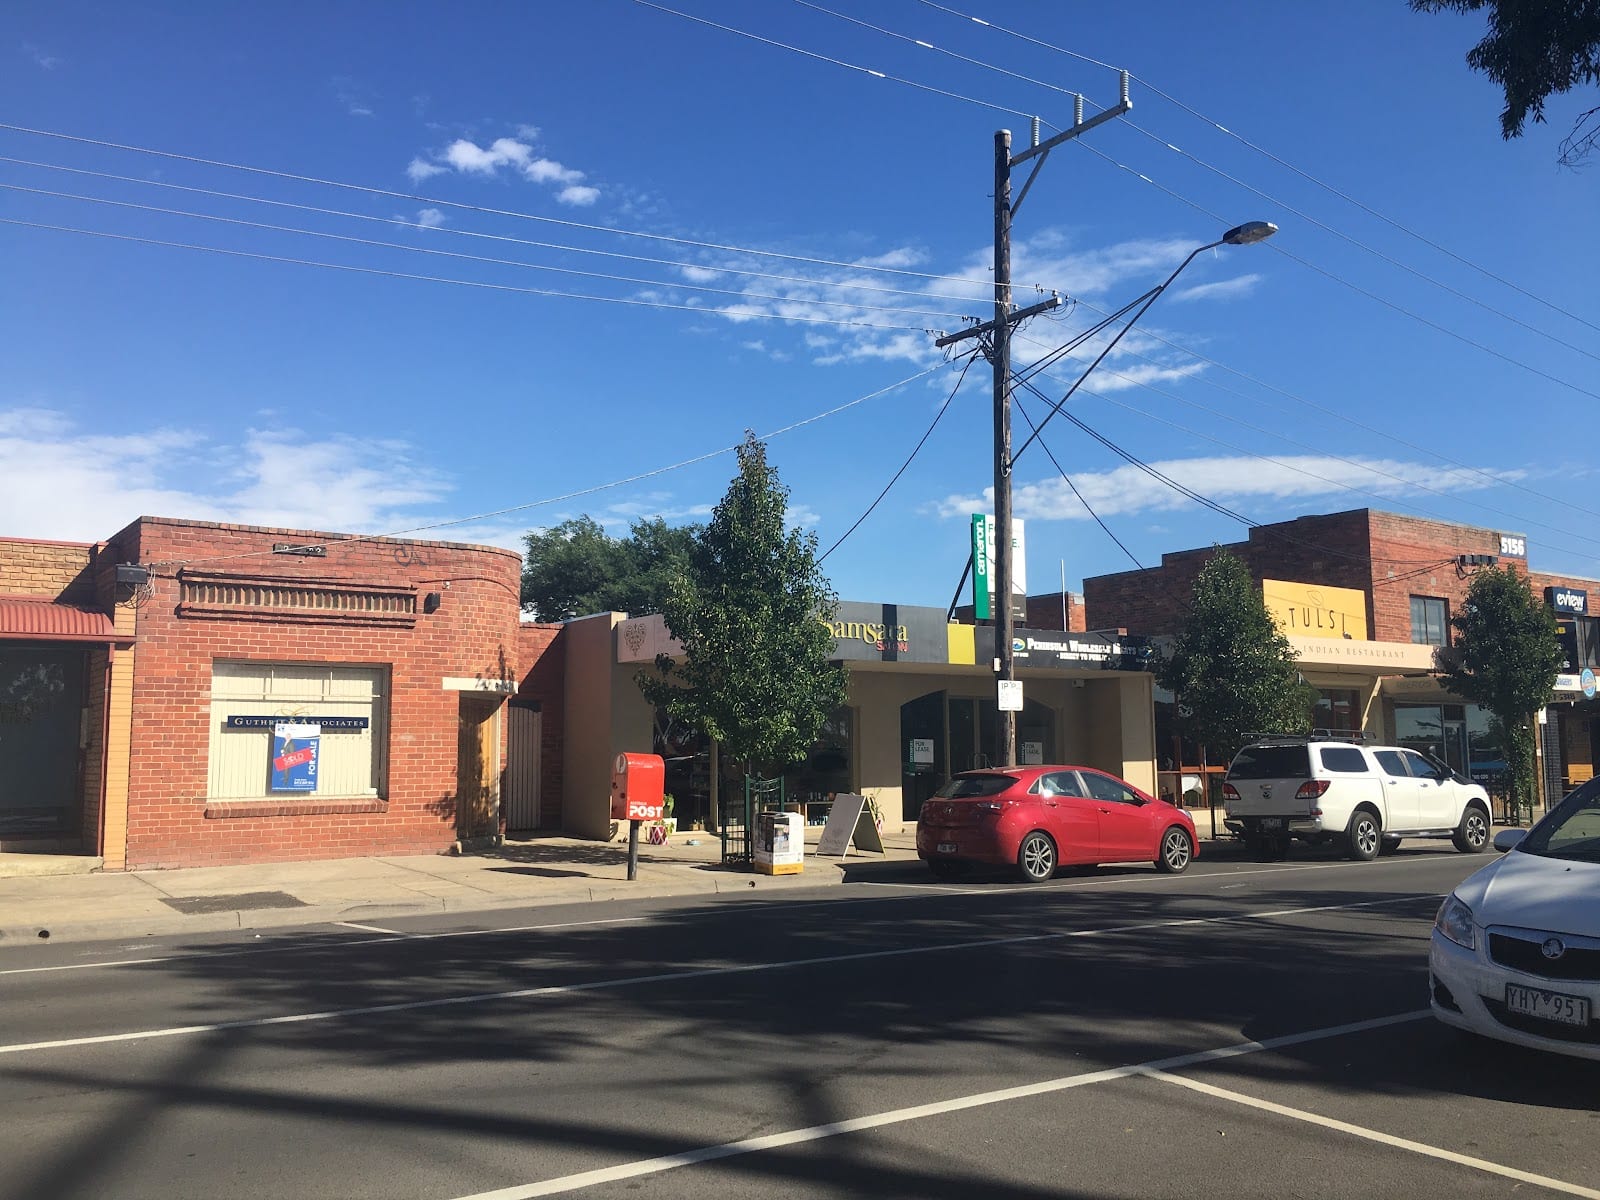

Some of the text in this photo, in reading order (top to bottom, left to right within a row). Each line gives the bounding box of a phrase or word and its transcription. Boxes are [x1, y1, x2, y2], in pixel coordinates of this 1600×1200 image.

[1501, 537, 1525, 555] 5156
[1556, 590, 1585, 607] eview
[1288, 608, 1346, 633] TULSI
[1303, 645, 1405, 659] INDIAN RESTAURANT
[234, 717, 286, 727] GUTHRIE
[629, 805, 664, 818] POST
[1508, 987, 1585, 1020] YHY 951
